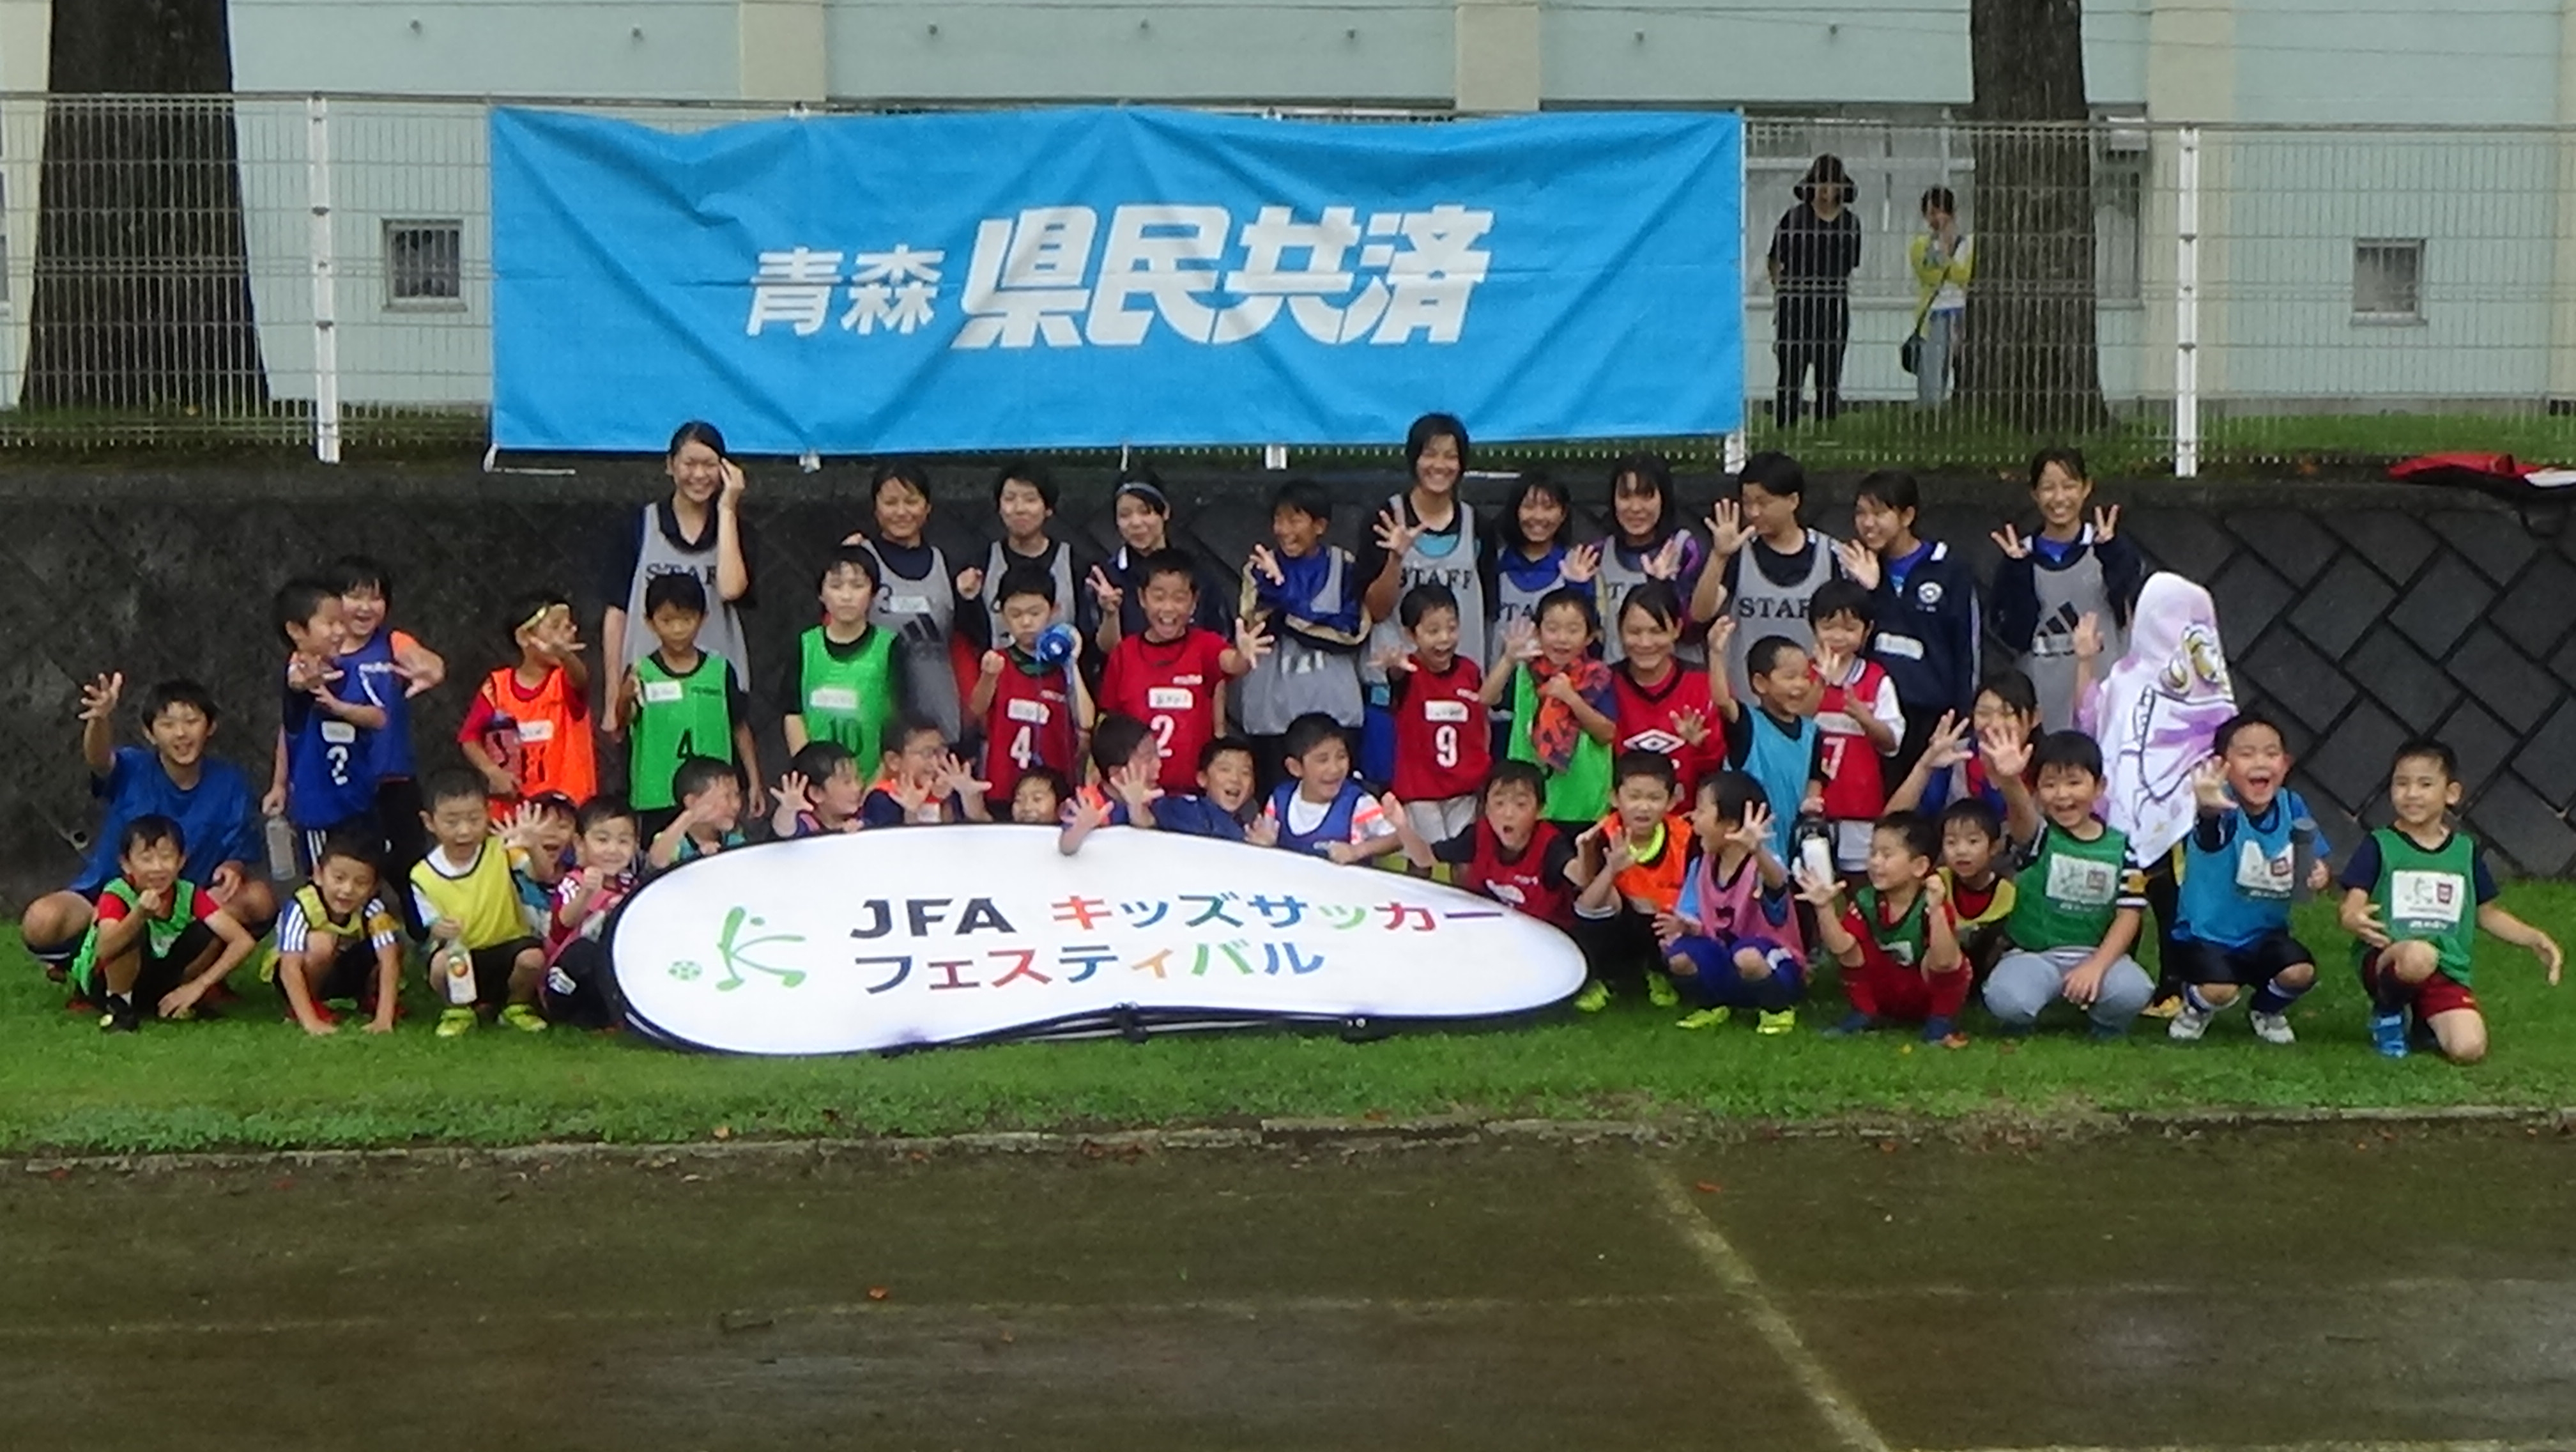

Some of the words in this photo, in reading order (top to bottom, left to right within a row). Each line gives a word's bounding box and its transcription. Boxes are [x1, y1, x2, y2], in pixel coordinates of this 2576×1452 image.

[1738, 597, 1811, 619] STAF
[1010, 725, 1032, 769] 4
[1151, 714, 1174, 757] 2
[1436, 724, 1457, 768] 9
[326, 745, 348, 786] 2
[850, 898, 1016, 939] JFA
[1052, 892, 1503, 932] キッズサッカー
[855, 941, 1324, 994] フェスティバル
